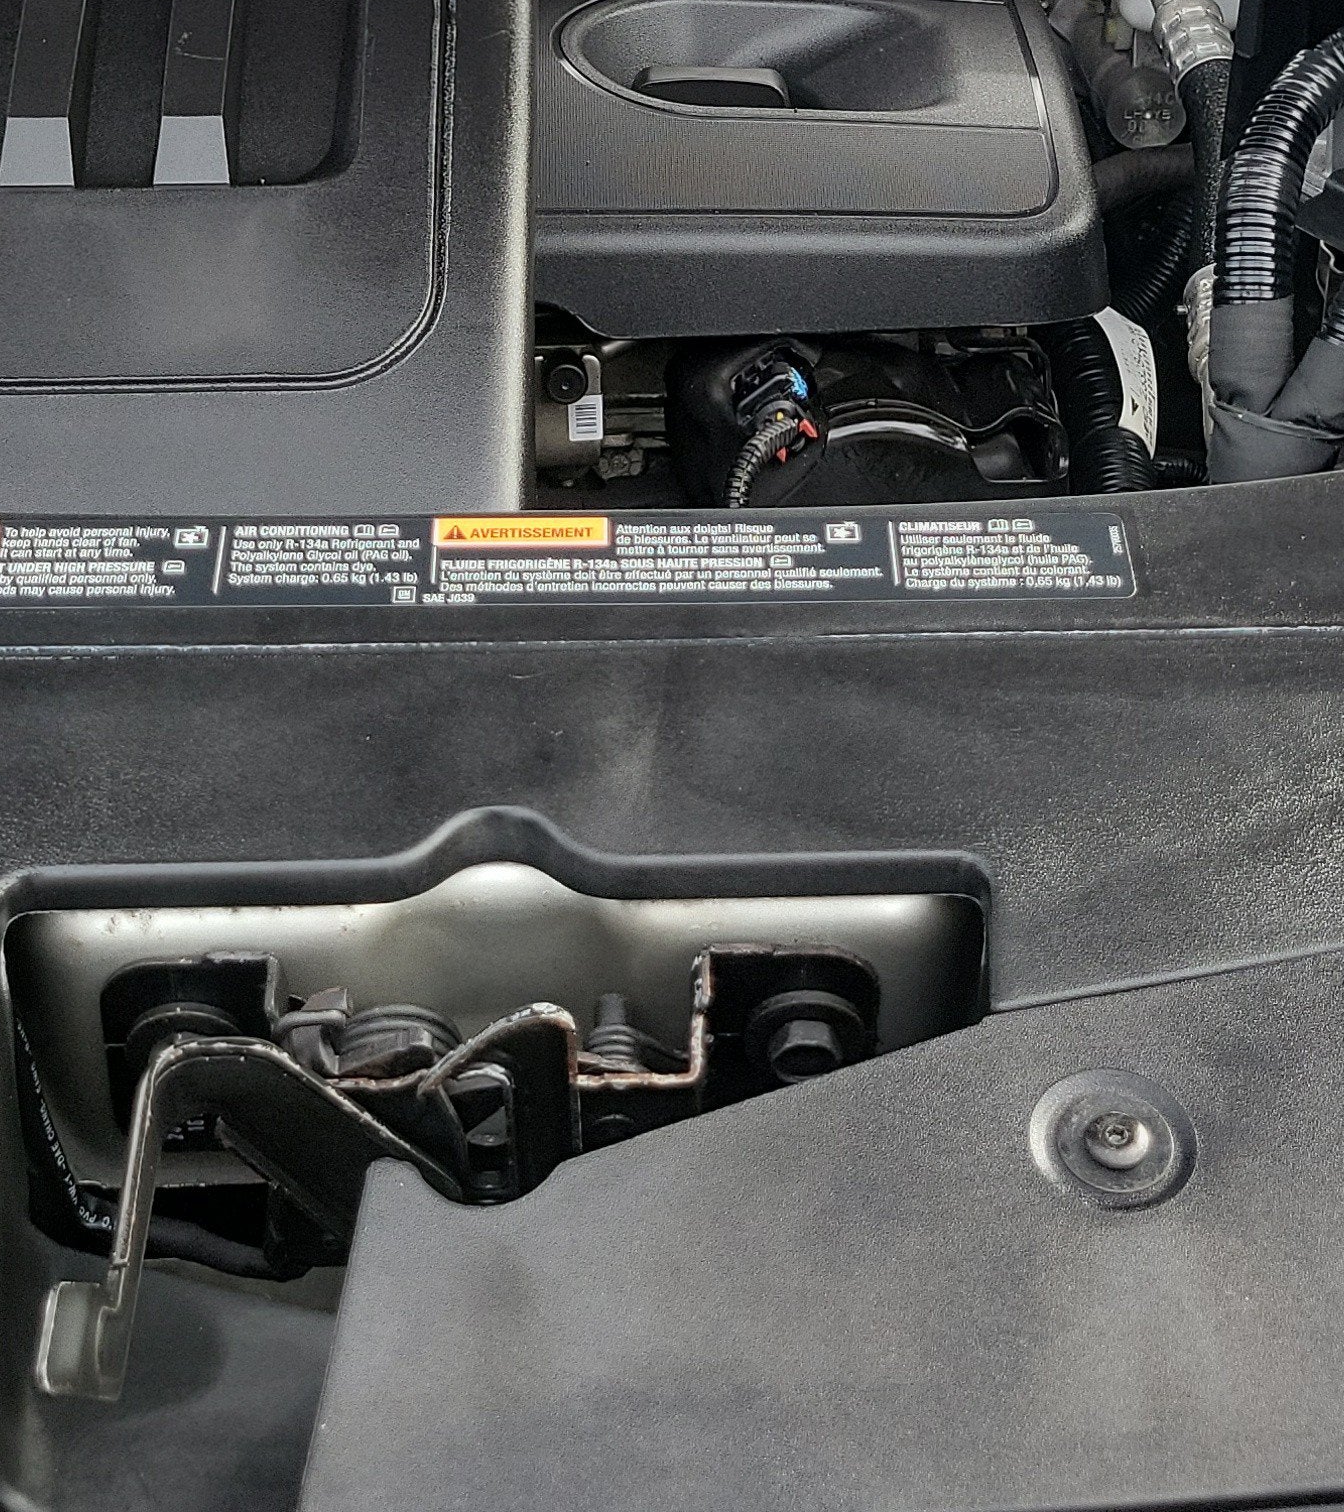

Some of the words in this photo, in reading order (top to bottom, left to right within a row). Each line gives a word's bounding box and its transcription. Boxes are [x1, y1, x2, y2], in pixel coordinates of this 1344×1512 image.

[6, 527, 19, 538] To
[21, 527, 46, 540] help
[48, 526, 80, 537] avoid
[82, 527, 133, 539] personal
[234, 526, 257, 536] AIR
[260, 525, 348, 536] CONDITIONING
[470, 527, 594, 538] AVERTISSEMENT
[617, 524, 666, 534] Attention
[670, 524, 691, 533] aux
[735, 523, 774, 534] Risque
[899, 522, 981, 532] CLIMATISEUR
[2, 537, 31, 550] keep
[33, 537, 69, 548] hands
[72, 537, 101, 548] clear
[103, 537, 115, 547] of
[116, 537, 140, 547] fan.
[233, 539, 255, 549] Use
[258, 538, 282, 551] only
[285, 538, 328, 548] R-134a
[331, 538, 395, 551] Refrigerant
[399, 538, 420, 548] and
[616, 534, 631, 544] de
[634, 534, 692, 544] blessures.
[694, 534, 709, 543] Le
[712, 534, 771, 544] ventilateur
[774, 534, 802, 545] peut
[805, 534, 817, 542] se
[900, 534, 940, 544] Utiliser
[942, 534, 1003, 544] seulement
[1005, 534, 1015, 544] le
[1018, 533, 1050, 543] fluide
[10, 549, 32, 558] can
[35, 548, 62, 558] start
[64, 548, 77, 558] at
[79, 549, 102, 560] any
[105, 547, 133, 557] time.
[231, 550, 303, 562] Polyalkylene
[306, 550, 342, 561] Glycol
[345, 550, 358, 560] oil
[361, 550, 388, 561] (PAG
[391, 549, 412, 561] oil).
[617, 545, 654, 555] mettre
[668, 545, 709, 554] tourner
[712, 545, 739, 554] sans
[742, 544, 826, 554] avertissement.
[966, 545, 1009, 555] R-134a
[1012, 545, 1024, 555] et
[1027, 545, 1041, 554] de
[8, 562, 51, 573] UNDER
[53, 562, 86, 572] HIGH
[89, 561, 155, 571] PRESSURE
[441, 560, 485, 570] FLUIDE
[573, 559, 618, 569] R-134a
[620, 559, 654, 568] SOUS
[658, 558, 698, 568] HAUTE
[701, 558, 763, 568] PRESSION
[903, 557, 918, 566] au
[1027, 555, 1059, 566] (huile
[230, 562, 252, 572] The
[255, 562, 297, 574] system
[300, 562, 349, 572] contains
[351, 561, 377, 573] dye.
[905, 567, 919, 576] Le
[921, 567, 970, 579] système
[973, 566, 1020, 576] contient
[1023, 566, 1037, 576] du
[1039, 565, 1090, 575] colorant.
[0, 574, 14, 587] by
[16, 574, 66, 586] qualified
[69, 574, 128, 585] personnel
[130, 573, 157, 585] only.
[228, 573, 271, 585] System
[275, 573, 319, 585] charge:
[322, 573, 348, 583] 0.65
[352, 573, 366, 585] kg
[369, 572, 399, 584] (1.43
[403, 572, 418, 583] lb)
[506, 571, 520, 581] du
[522, 571, 571, 583] système
[574, 570, 596, 580] doit
[599, 570, 622, 580] être
[625, 570, 672, 580] effectué
[674, 571, 694, 582] par
[697, 570, 712, 579] un
[715, 569, 771, 580] personnel
[774, 568, 816, 580] qualifié
[819, 567, 884, 577] seulement.
[440, 582, 463, 592] Des
[465, 581, 524, 592] méthodes
[591, 581, 656, 591] incorrectes
[659, 581, 705, 593] peuvent
[708, 581, 748, 590] causer
[750, 579, 772, 589] des
[774, 579, 834, 589] blessures.
[906, 578, 947, 591] Charge
[950, 578, 965, 588] du
[968, 577, 1017, 590] système
[1026, 576, 1053, 588] 0,65
[1056, 576, 1070, 588] kg
[1073, 576, 1104, 588] (1,43
[1106, 576, 1121, 587] lb)
[19, 587, 45, 597] may
[48, 587, 84, 596] cause
[86, 585, 138, 597] personal
[140, 584, 175, 596] injury.
[423, 594, 445, 603] SAE
[78, 1205, 97, 1223] PVC
